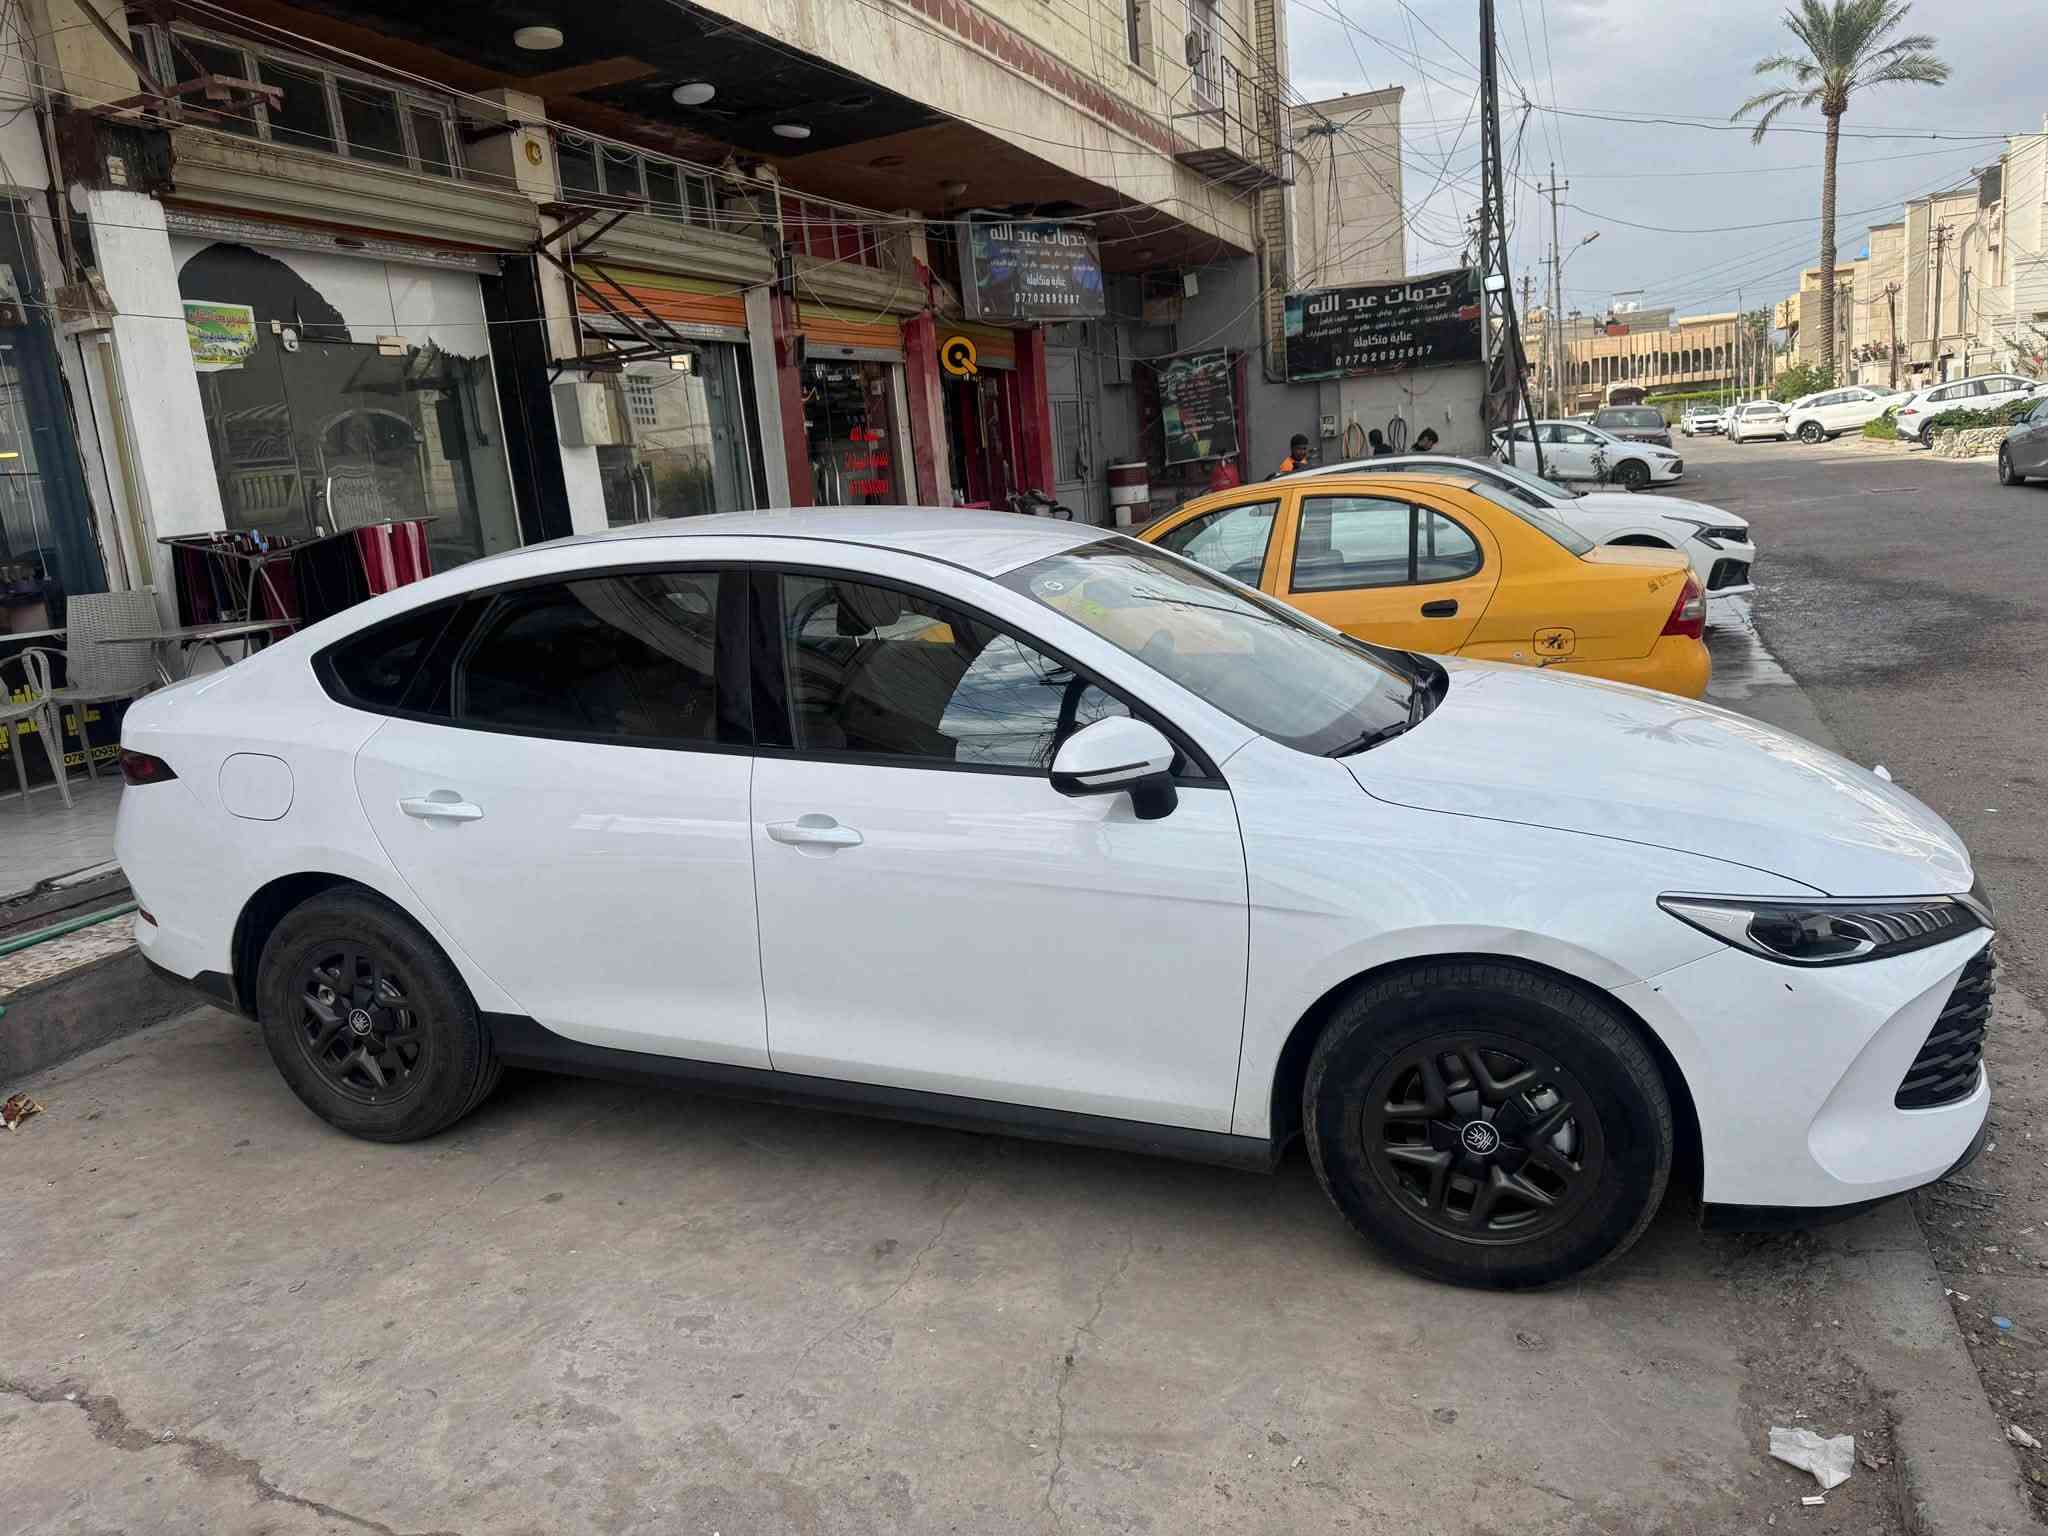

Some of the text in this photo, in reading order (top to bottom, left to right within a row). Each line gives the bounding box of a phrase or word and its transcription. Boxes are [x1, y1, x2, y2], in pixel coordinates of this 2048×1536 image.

[991, 223, 1087, 247] خدمات عبد الله
[1308, 280, 1452, 315] خدمات عبد الله
